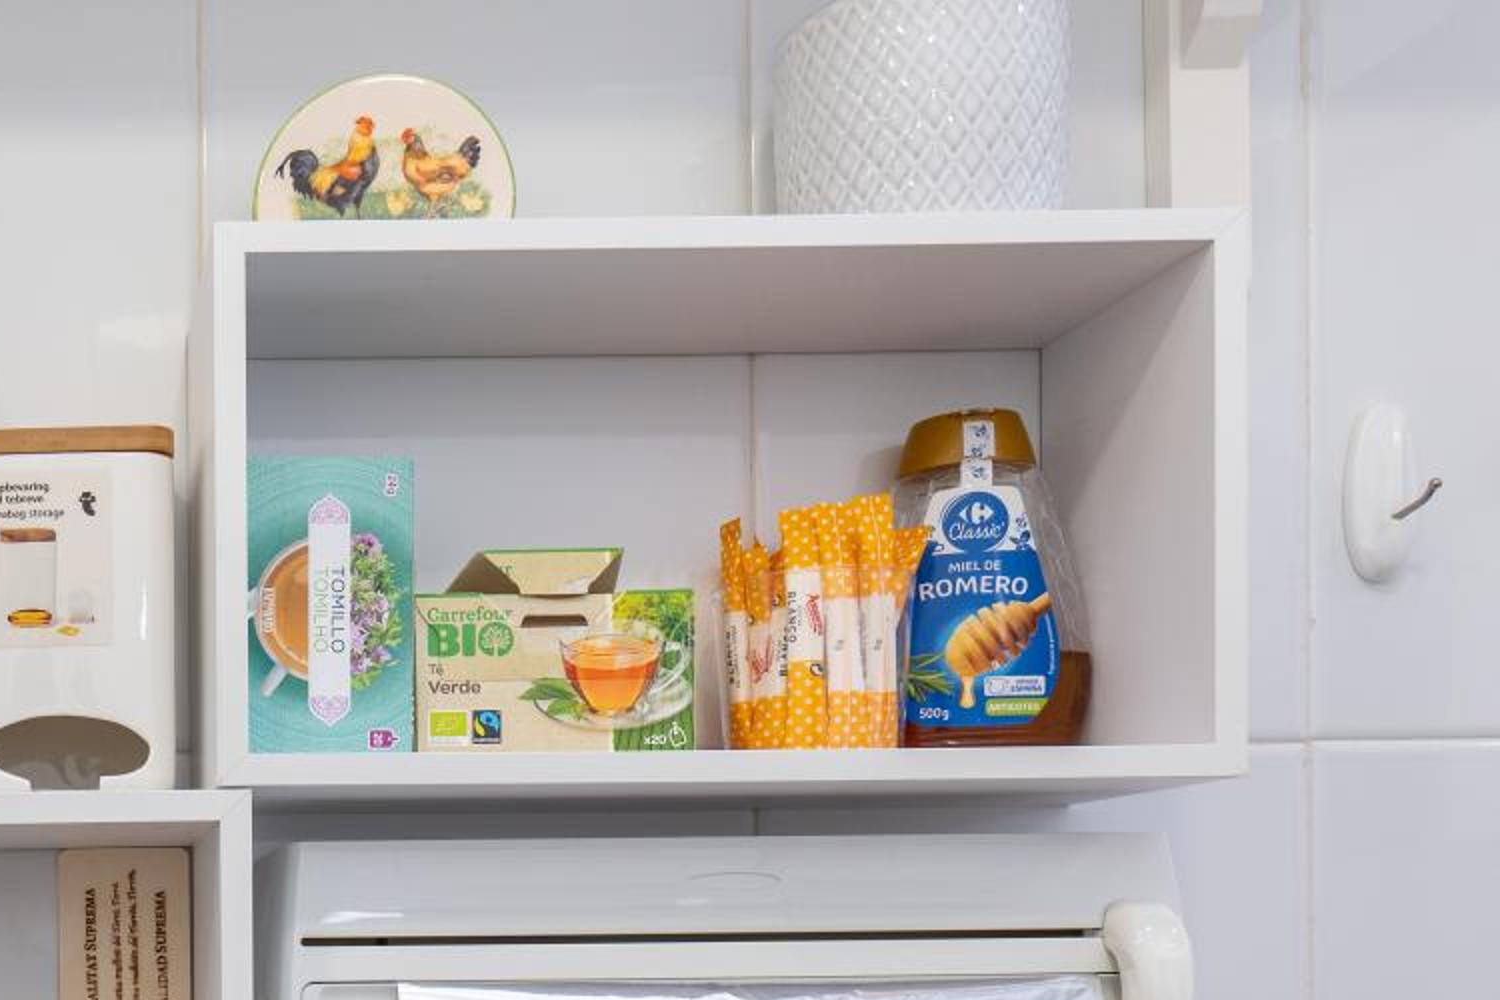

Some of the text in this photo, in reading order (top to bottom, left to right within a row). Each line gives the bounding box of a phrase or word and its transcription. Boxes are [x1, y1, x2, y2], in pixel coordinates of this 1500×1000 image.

[29, 508, 65, 520] storage
[948, 559, 1002, 574] MIEL DE
[918, 575, 1029, 602] ROMERO
[331, 566, 346, 655] TOMILLO
[427, 606, 514, 623] Carrefour
[427, 622, 515, 657] BIO
[428, 679, 482, 695] Verde
[919, 707, 950, 721] 500g
[84, 887, 98, 952] SUPREMA
[155, 890, 168, 953] SUPREMA
